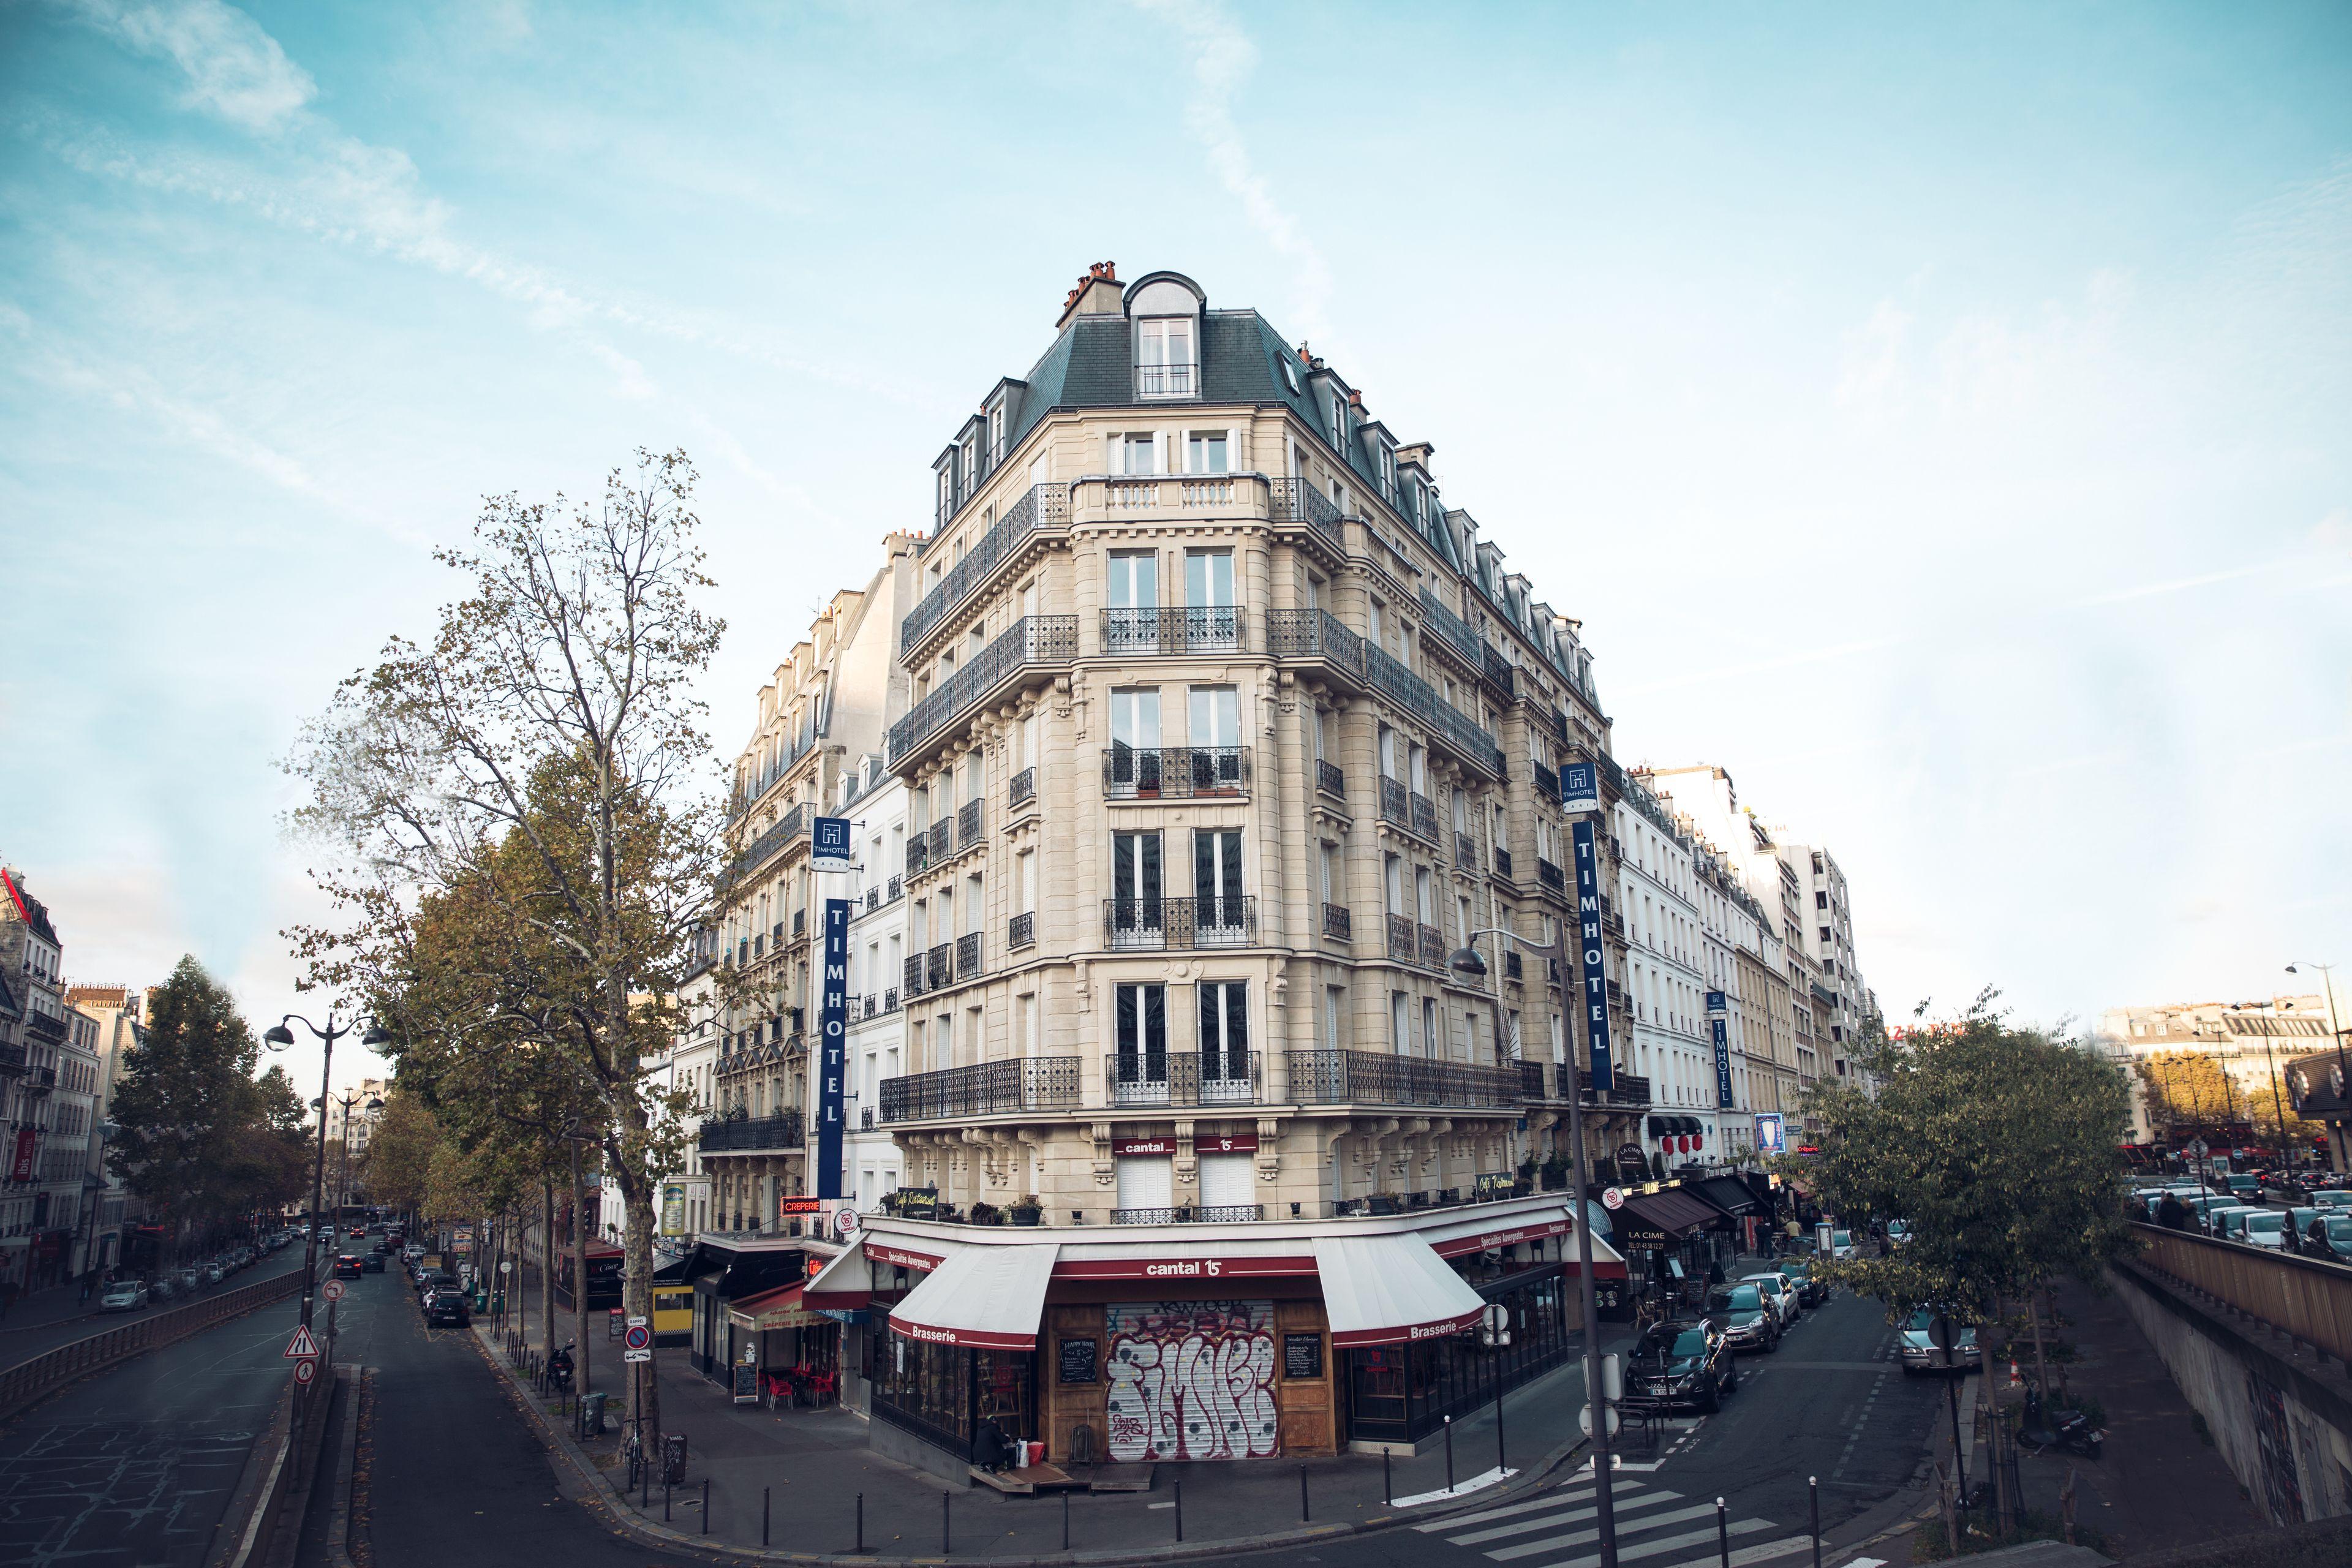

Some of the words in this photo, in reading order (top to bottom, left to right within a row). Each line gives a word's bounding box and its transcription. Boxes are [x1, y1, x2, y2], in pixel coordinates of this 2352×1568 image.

[1578, 842, 1605, 1049] TIMHOTEL
[826, 910, 845, 1121] TIMHOTEL
[1716, 1021, 1728, 1101] TIMHOTEL
[1125, 1142, 1164, 1153] cantal
[1220, 1139, 1232, 1151] 15
[1627, 1147, 1642, 1155] CIME
[17, 1158, 30, 1174] ibis
[785, 1202, 820, 1211] CREPERIE
[1480, 1235, 1501, 1249] Spécialités
[1502, 1231, 1524, 1243] Auvergnates
[1548, 1223, 1566, 1234] Restaurant
[888, 1251, 907, 1264] Spécialités
[907, 1254, 930, 1269] Auvergnates
[1147, 1261, 1200, 1276] cantal
[1204, 1259, 1223, 1276] 15
[913, 1325, 956, 1343] Brasserie
[1411, 1320, 1457, 1340] Brasserie
[1065, 1341, 1081, 1351] HAPPY
